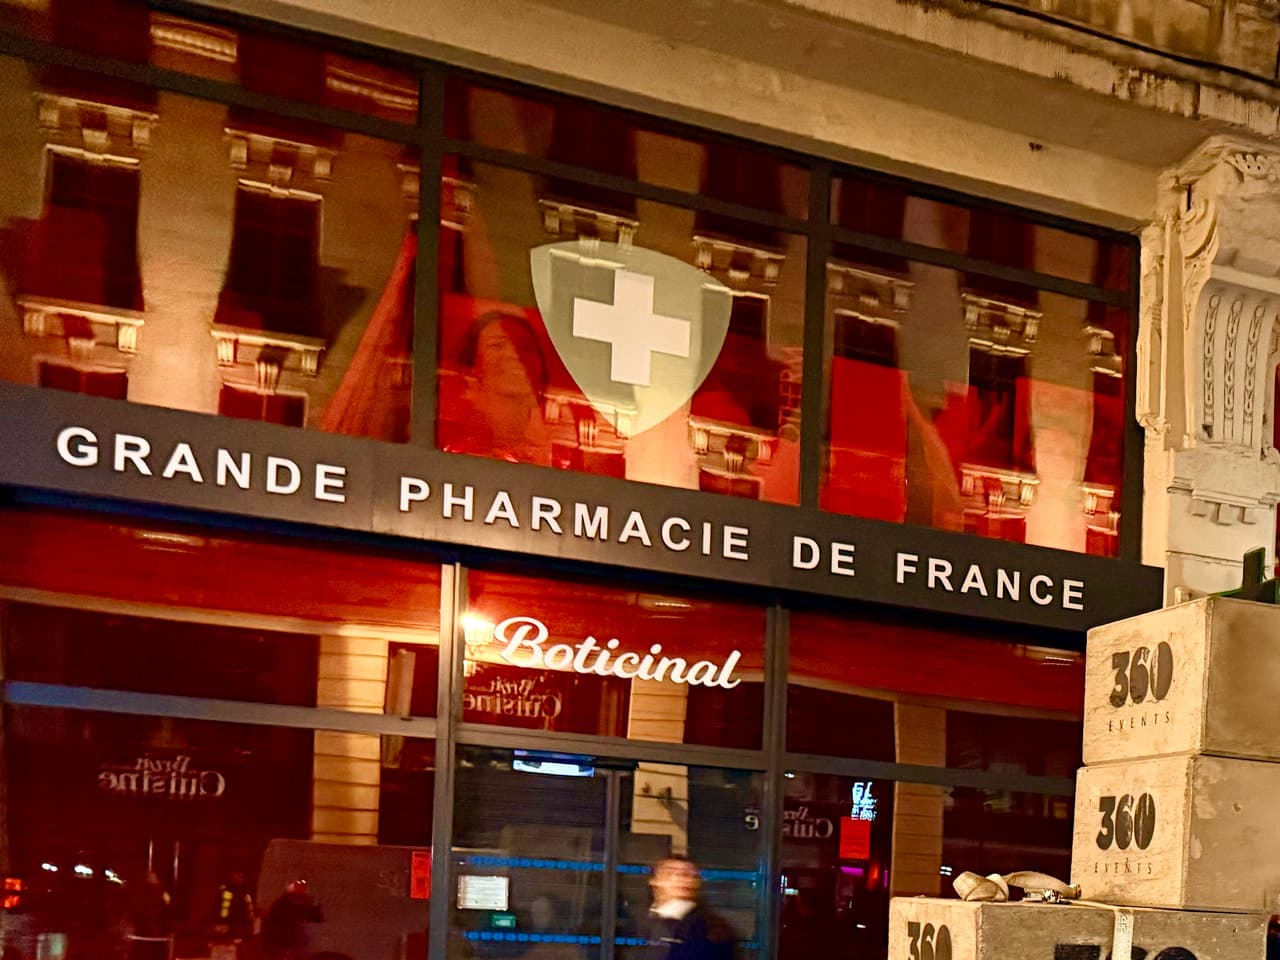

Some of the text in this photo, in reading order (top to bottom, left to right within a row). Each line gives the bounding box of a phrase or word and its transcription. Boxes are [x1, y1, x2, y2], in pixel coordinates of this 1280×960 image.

[56, 426, 1086, 611] GRANDE PHARMACIE DE FRANCE
[492, 616, 742, 689] Boticinal
[1109, 641, 1174, 708] 360
[1109, 711, 1170, 732] EVENTS
[1096, 792, 1156, 851] 360
[1094, 860, 1153, 876] EVENTS
